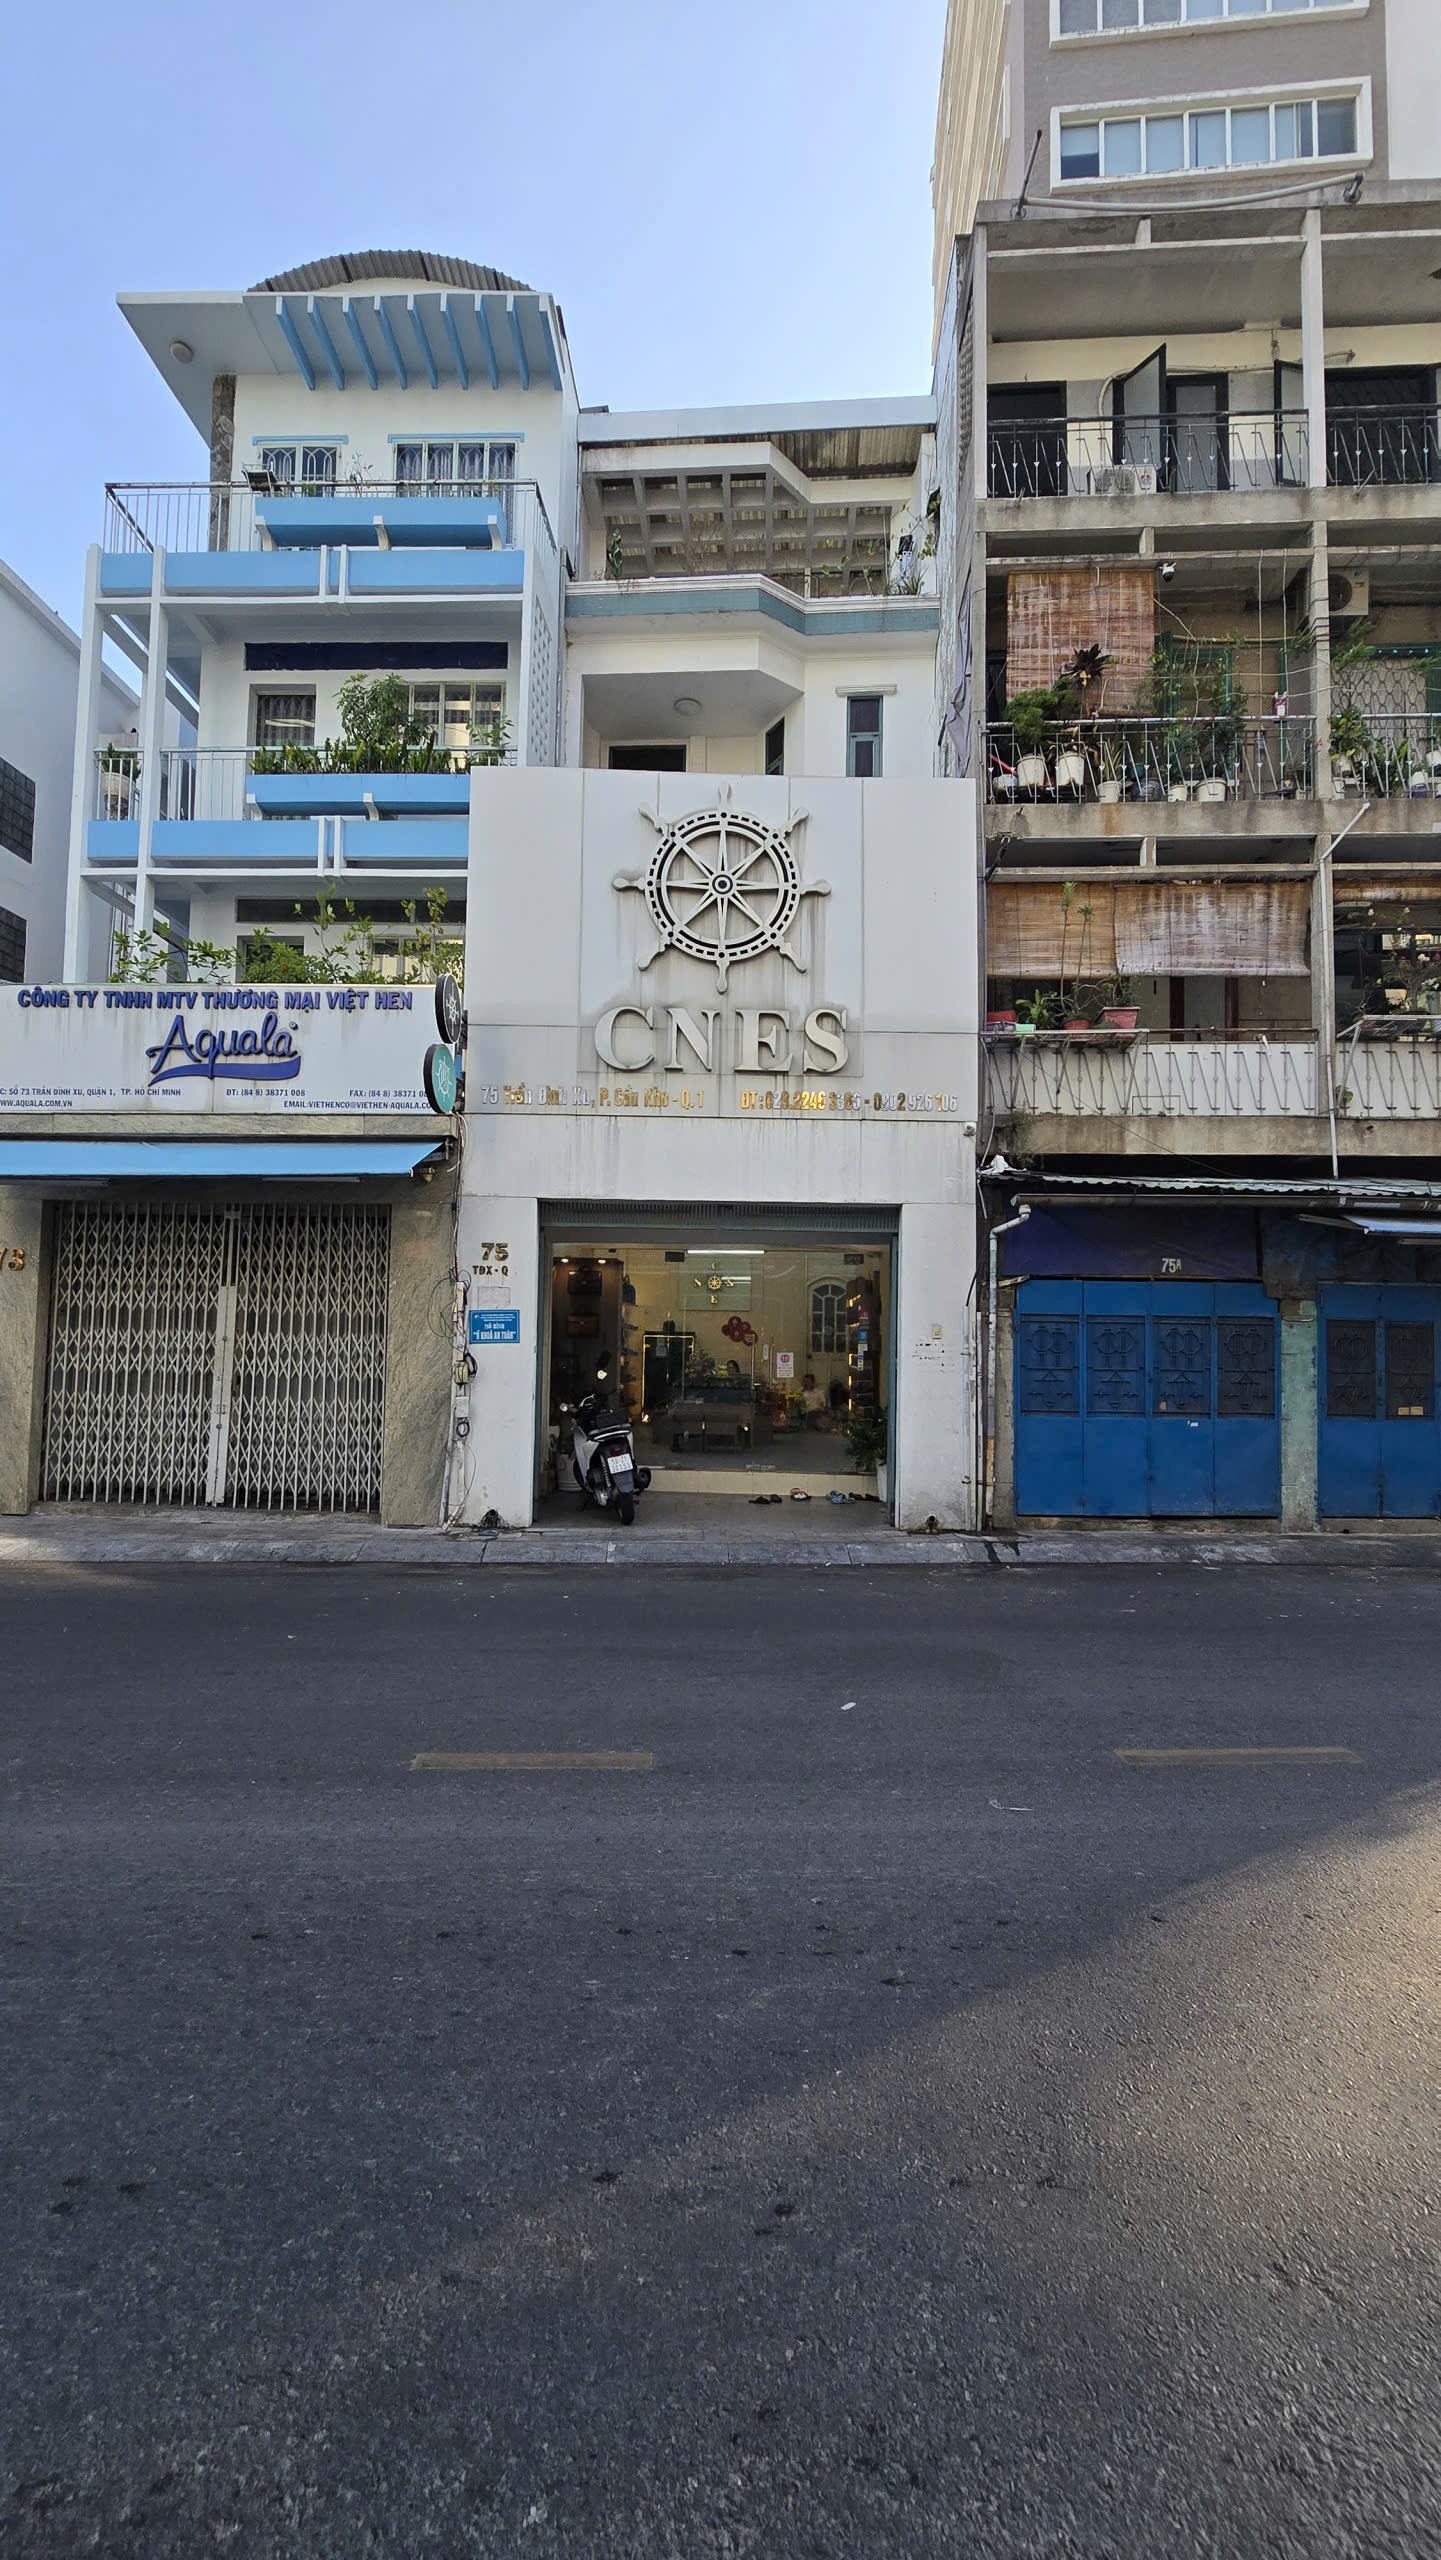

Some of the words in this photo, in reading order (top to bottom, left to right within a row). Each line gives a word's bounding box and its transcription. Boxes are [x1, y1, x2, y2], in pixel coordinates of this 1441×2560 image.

[18, 986, 70, 1008] CÔNG
[74, 991, 98, 1008] TY
[104, 991, 152, 1008] TNHH
[157, 992, 197, 1009] MTV
[202, 989, 278, 1009] THƯƠNG
[284, 992, 320, 1013] MẠI
[326, 987, 368, 1013] VIỆT
[375, 992, 413, 1009] HEN
[145, 1011, 298, 1080] Aquala
[594, 1006, 849, 1073] CNES
[21, 1088, 30, 1096] 73
[121, 1088, 132, 1096] TP.
[162, 1088, 181, 1096] MINH
[265, 1089, 288, 1097] 38371
[349, 1089, 367, 1097] FAX:
[393, 1090, 416, 1098] 38371
[481, 1085, 498, 1104] 75
[697, 1088, 705, 1108] 1
[481, 1242, 509, 1261] 75
[1161, 1257, 1182, 1273] 75A
